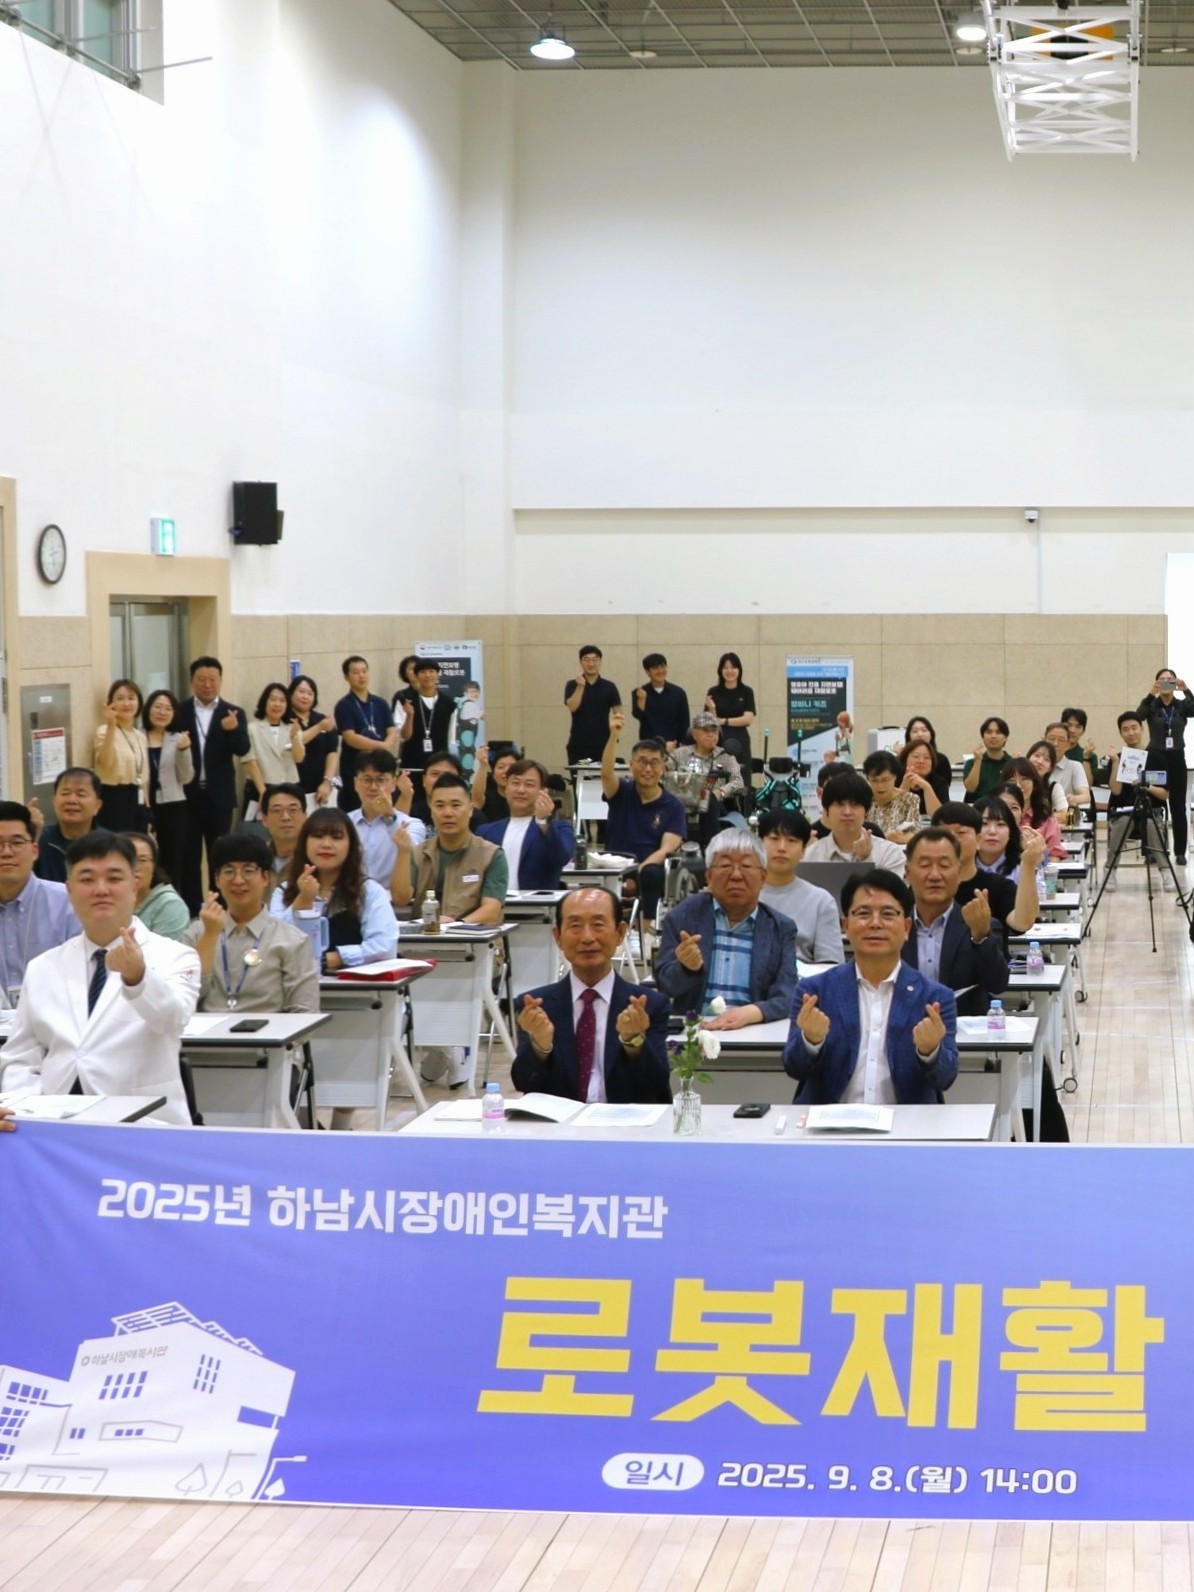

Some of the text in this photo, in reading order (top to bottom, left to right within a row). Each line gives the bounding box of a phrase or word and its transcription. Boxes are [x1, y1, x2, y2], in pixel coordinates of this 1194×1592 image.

[97, 1178, 669, 1240] 2025년 하남시장애인복지관
[476, 1276, 1165, 1432] 로봇재활
[625, 1460, 1078, 1495] 일시 2025. 9. 8.(월) 14:00
